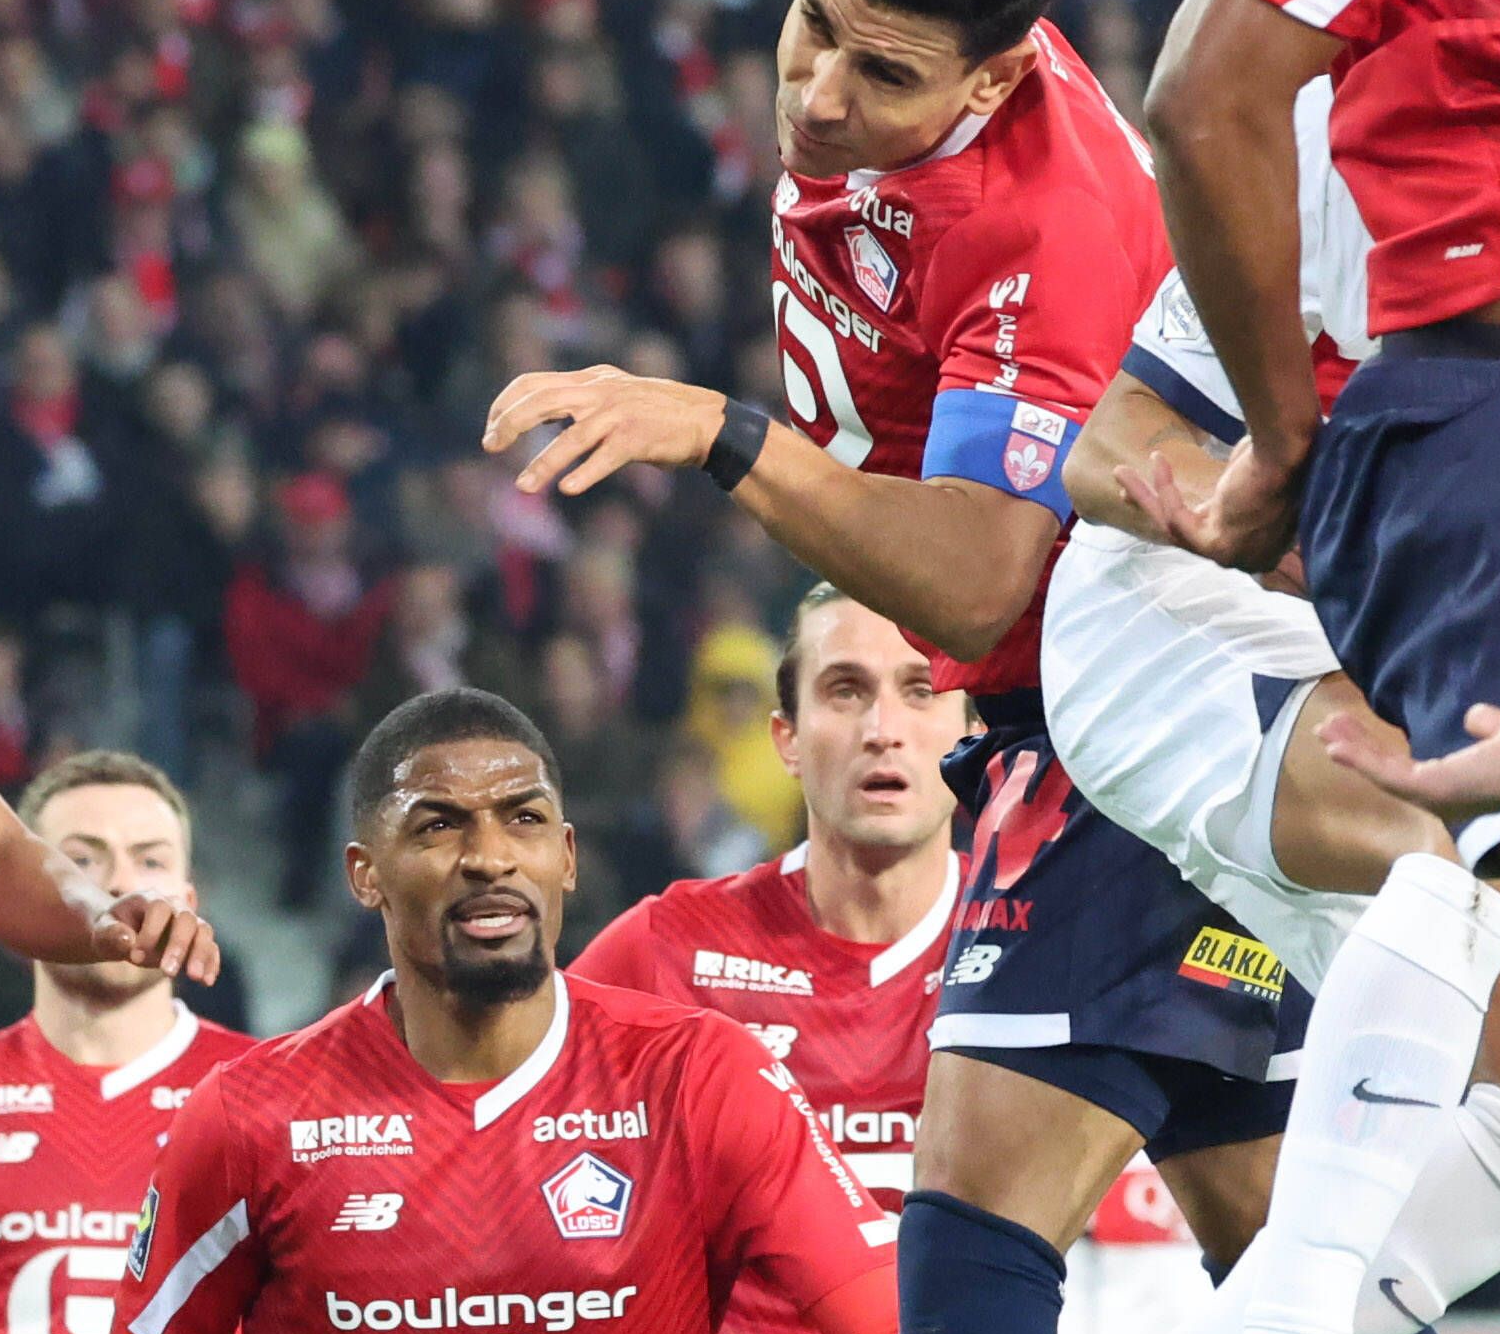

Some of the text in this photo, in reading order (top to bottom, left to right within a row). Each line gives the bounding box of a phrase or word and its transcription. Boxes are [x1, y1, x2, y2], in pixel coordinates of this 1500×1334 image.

[847, 185, 915, 240] ctua
[772, 211, 887, 354] oulanger
[724, 955, 814, 990] RIKA
[320, 1114, 413, 1147] RIKA
[532, 1100, 649, 1142] actual
[292, 1150, 309, 1163] Le
[344, 1142, 414, 1155] autrichien
[566, 1215, 615, 1231] LOSC
[326, 1285, 637, 1331] boulanger
